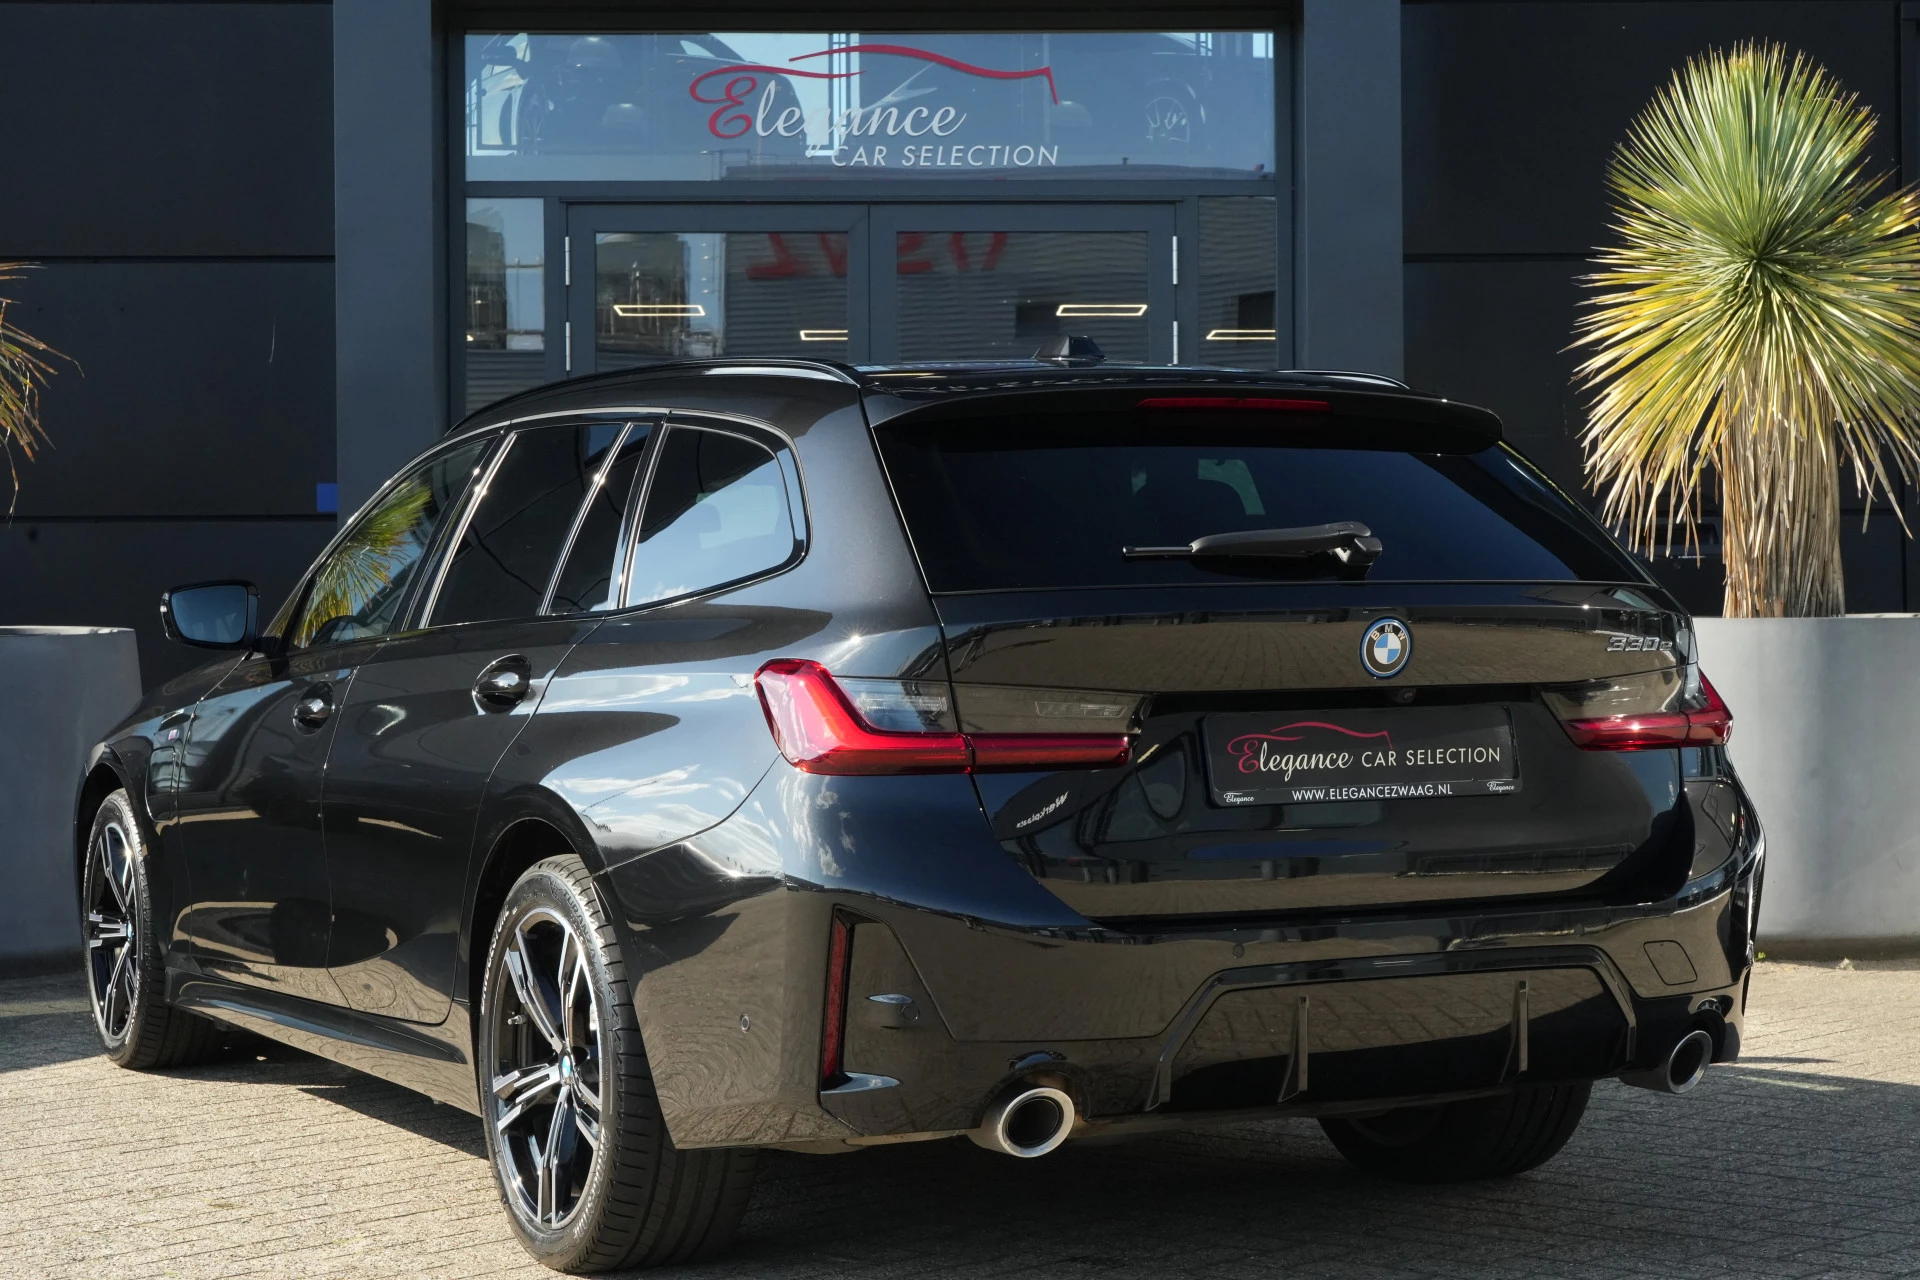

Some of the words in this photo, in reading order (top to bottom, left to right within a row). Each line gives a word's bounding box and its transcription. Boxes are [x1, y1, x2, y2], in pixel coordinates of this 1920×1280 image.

[689, 65, 966, 158] Elegance
[831, 146, 887, 167] CAR
[902, 145, 1058, 166] SELECTION
[1370, 624, 1406, 641] BMW
[1605, 636, 1673, 652] 330e
[1227, 734, 1354, 782] Elegance
[1361, 751, 1397, 767] CAR
[1406, 747, 1500, 765] SELECTION
[1292, 784, 1453, 801] WWW.ELEGANCEZWAAG.NL
